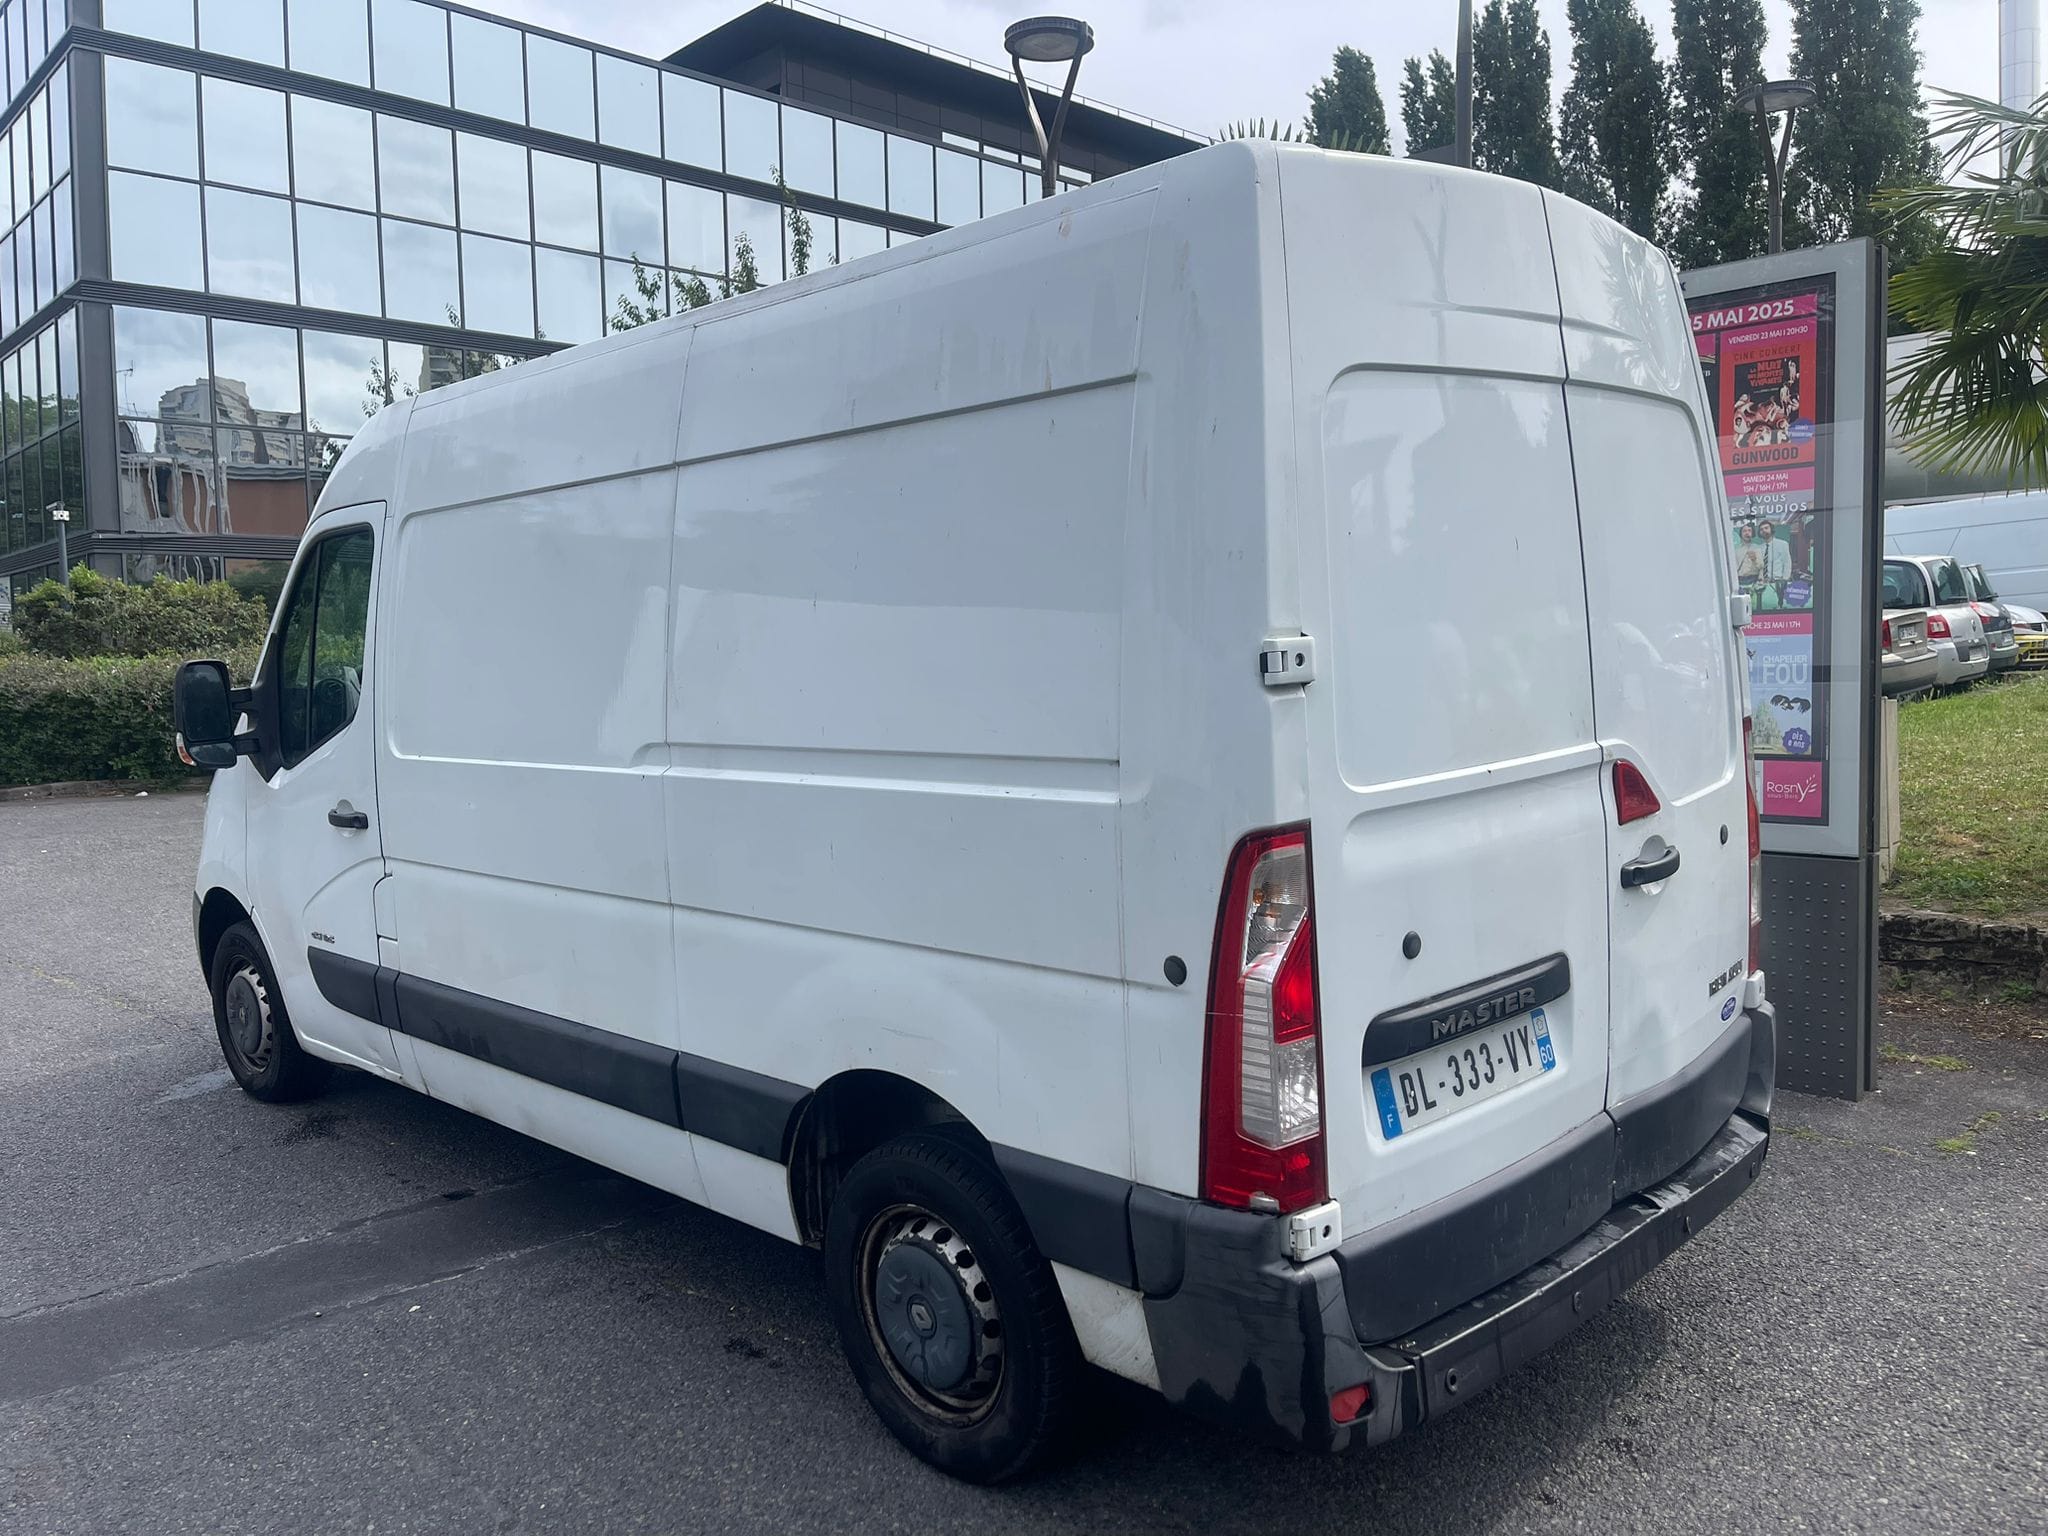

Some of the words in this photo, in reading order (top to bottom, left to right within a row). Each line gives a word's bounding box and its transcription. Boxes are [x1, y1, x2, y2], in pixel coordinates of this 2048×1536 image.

[1707, 308, 1743, 328] MAI
[1747, 300, 1794, 321] 2025
[1728, 332, 1760, 345] VENDREDI
[1761, 331, 1769, 340] 23
[1769, 328, 1783, 338] MAI
[1787, 325, 1809, 336] 20H30
[1759, 344, 1801, 358] CONCERT
[1732, 447, 1799, 465] GUNWOOD
[1743, 474, 1766, 484] SAMEDI
[1776, 472, 1789, 480] MAI
[1743, 485, 1754, 493] 15H
[1744, 495, 1752, 504] À
[1755, 494, 1786, 503] VOUS
[1750, 502, 1807, 515] STUDIOS
[1763, 621, 1771, 629] 25
[1772, 621, 1785, 629] MAI
[1789, 620, 1801, 628] 17H
[1762, 654, 1808, 664] CHAPELIER
[1762, 663, 1808, 685] FOU
[1431, 987, 1536, 1040] MASTER
[1386, 1113, 1394, 1128] F
[1399, 1025, 1533, 1118] DL-333-VY
[1539, 1043, 1553, 1065] 60
